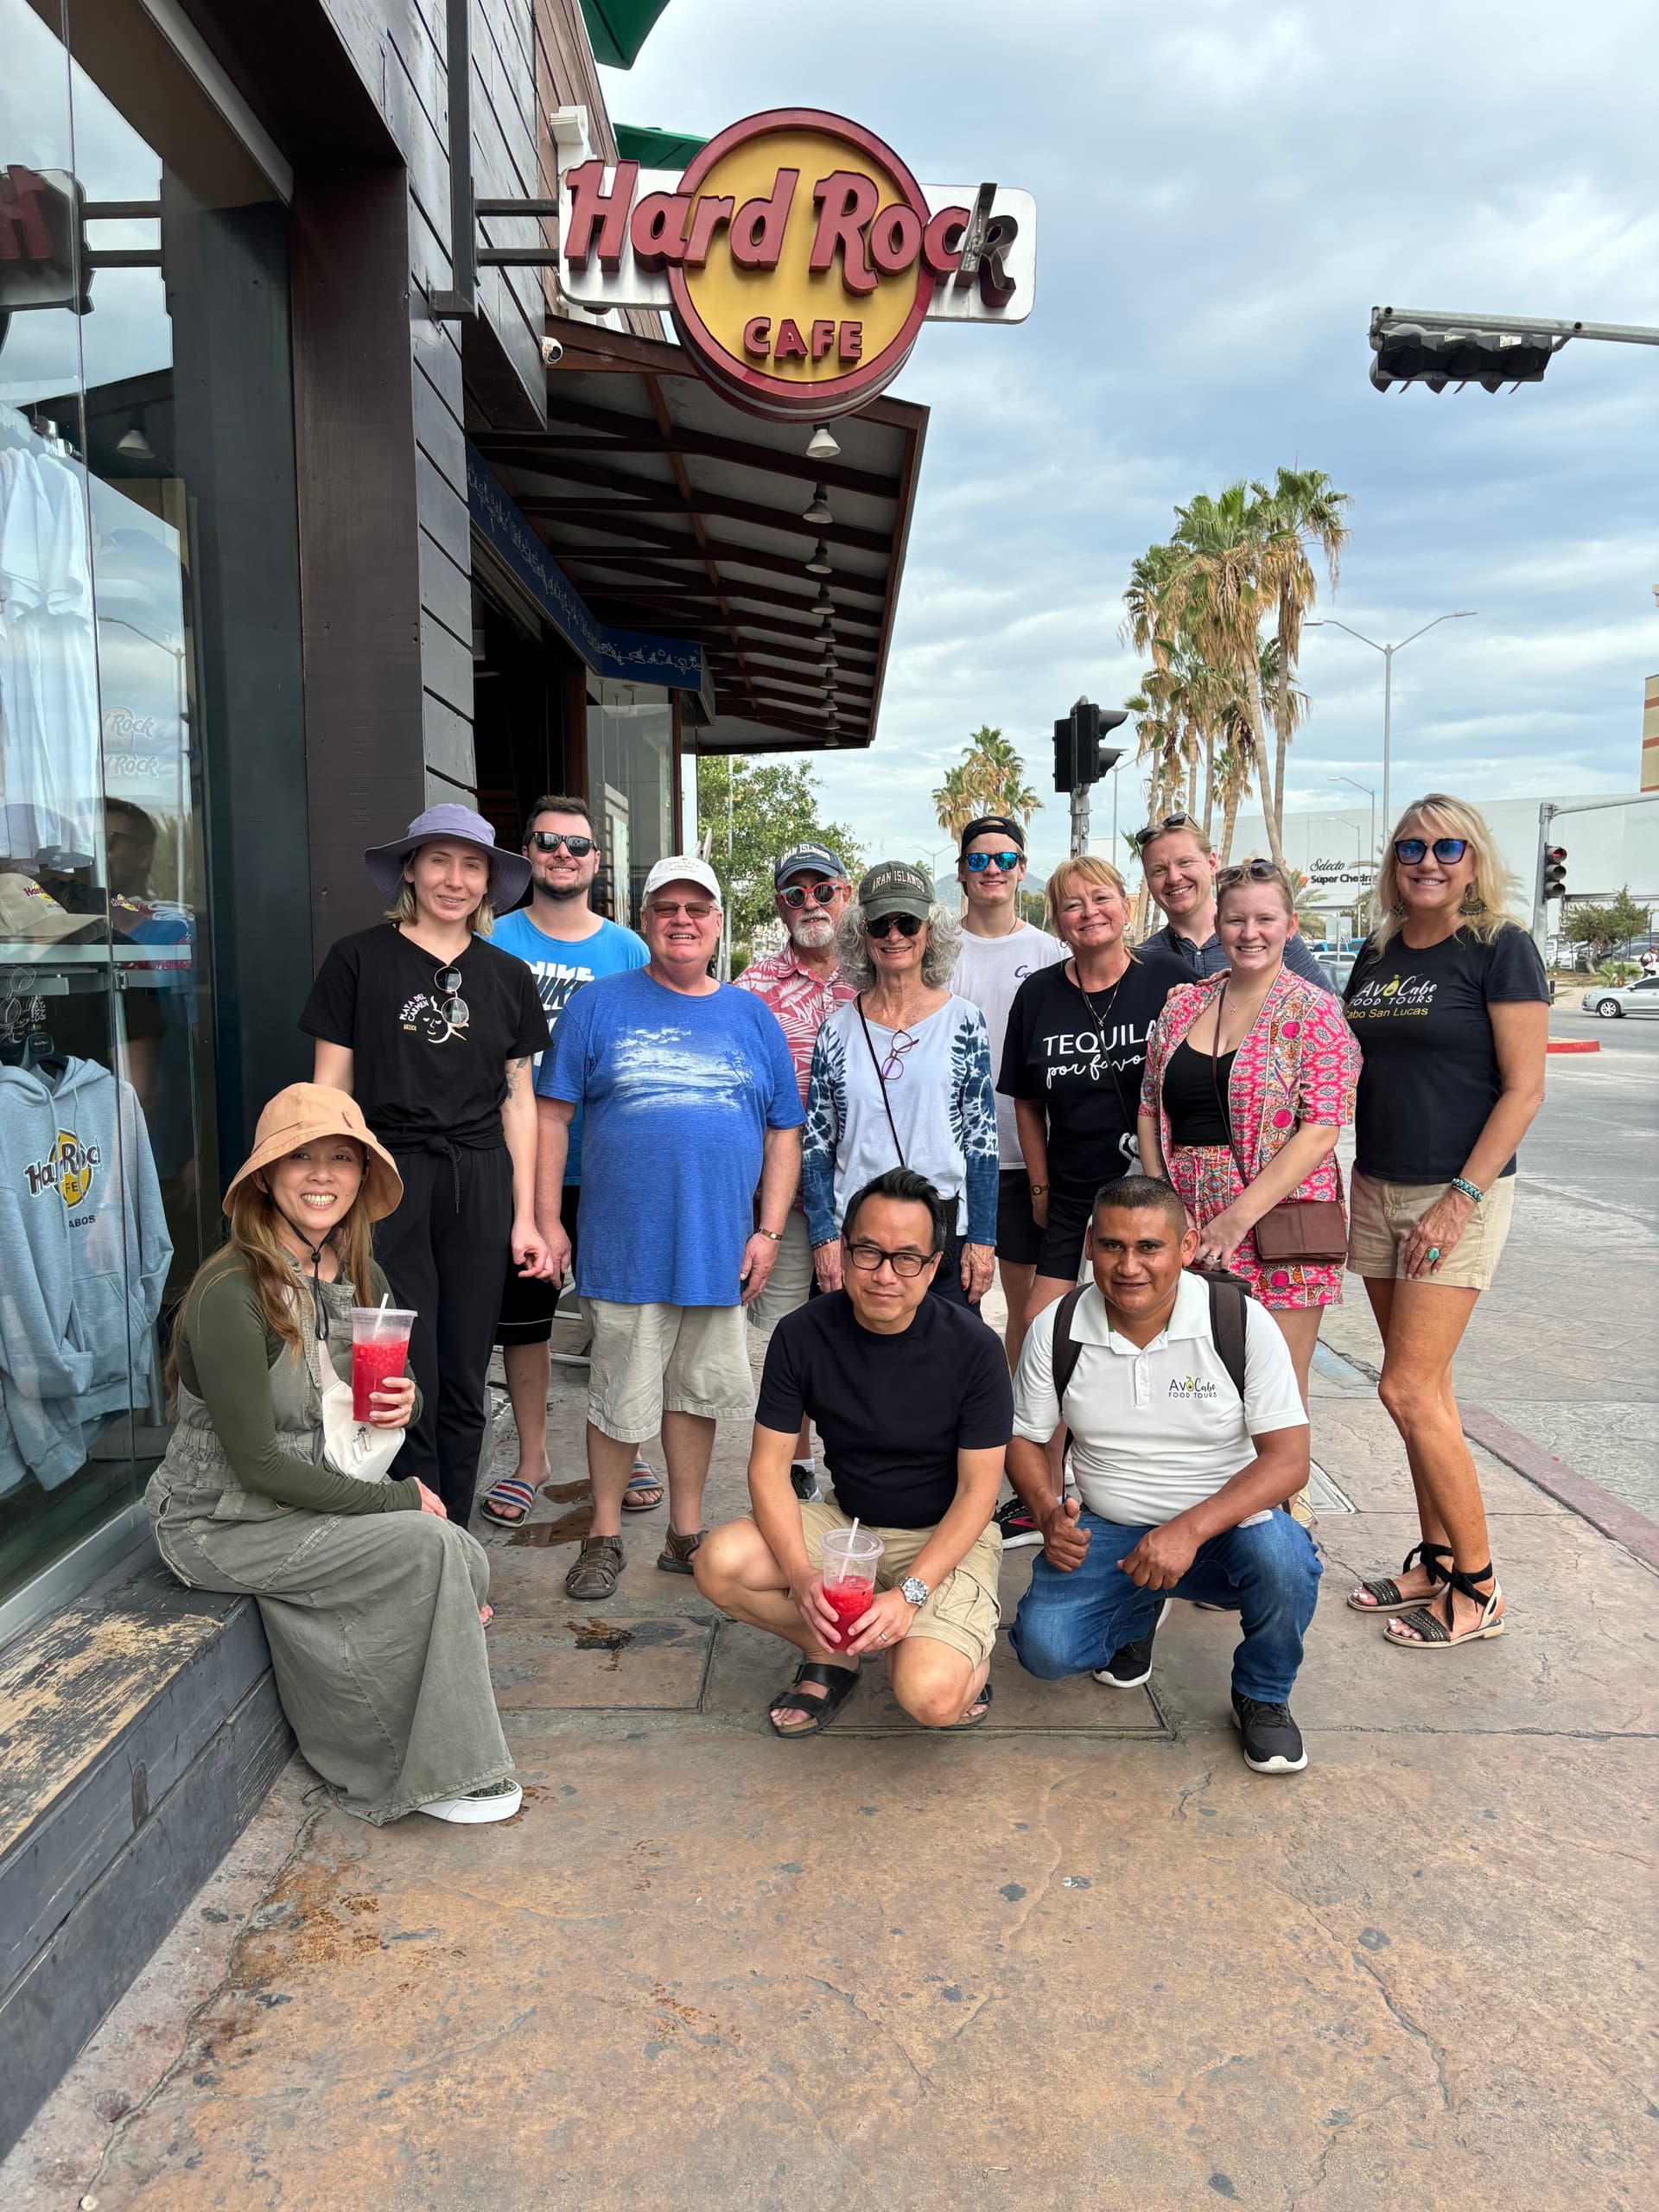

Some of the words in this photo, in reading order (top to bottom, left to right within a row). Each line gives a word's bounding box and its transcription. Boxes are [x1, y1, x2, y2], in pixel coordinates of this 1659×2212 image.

[564, 159, 799, 271] Hard
[809, 170, 1019, 307] Rock
[743, 316, 862, 362] CAFE
[1310, 858, 1345, 872] Selecto
[872, 872, 891, 893] ARAN
[893, 870, 925, 893] ISLANDS
[413, 993, 427, 1002] DEL
[1389, 995, 1433, 1006] TOURS
[408, 1000, 429, 1021] CARMEN
[1346, 1009, 1366, 1019] abo
[1369, 1008, 1390, 1018] San
[1393, 1007, 1428, 1017] Lucas
[1046, 1062, 1086, 1089] por
[1090, 1054, 1147, 1080] favo
